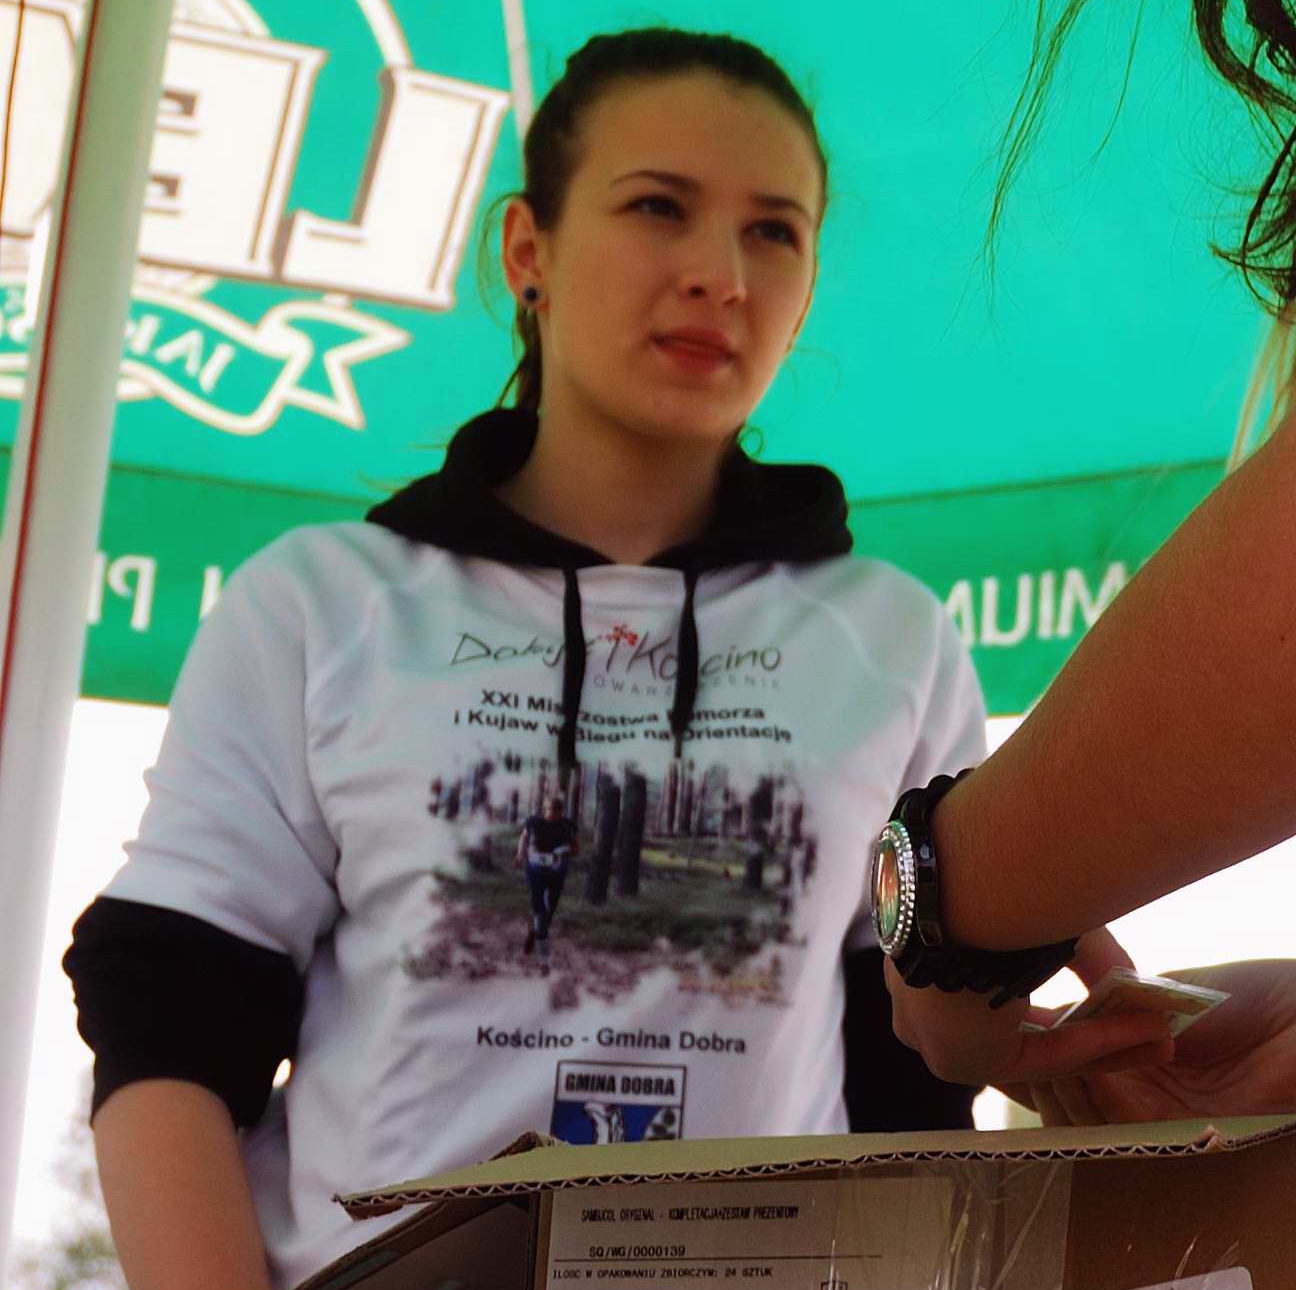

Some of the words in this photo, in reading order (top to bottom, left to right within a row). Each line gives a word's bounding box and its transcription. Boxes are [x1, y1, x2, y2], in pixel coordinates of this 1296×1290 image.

[626, 631, 783, 682] Kocino
[481, 688, 519, 709] XXI
[527, 695, 659, 727] Miszostwa
[666, 705, 766, 725] omorza
[468, 708, 538, 734] Kujaw
[643, 726, 674, 742] na
[476, 1025, 573, 1050] Kościno
[596, 1026, 671, 1050] Gmina
[679, 1030, 747, 1054] Dobra
[564, 1072, 617, 1094] GMINA
[620, 1076, 676, 1097] DOBRA
[588, 1245, 687, 1258] SQ/WG/0000139
[596, 1268, 657, 1279] OPAKOWANIU
[660, 1267, 718, 1279] ZBIORCZYM:
[724, 1267, 737, 1278] 24
[742, 1267, 774, 1278] SZTUK
